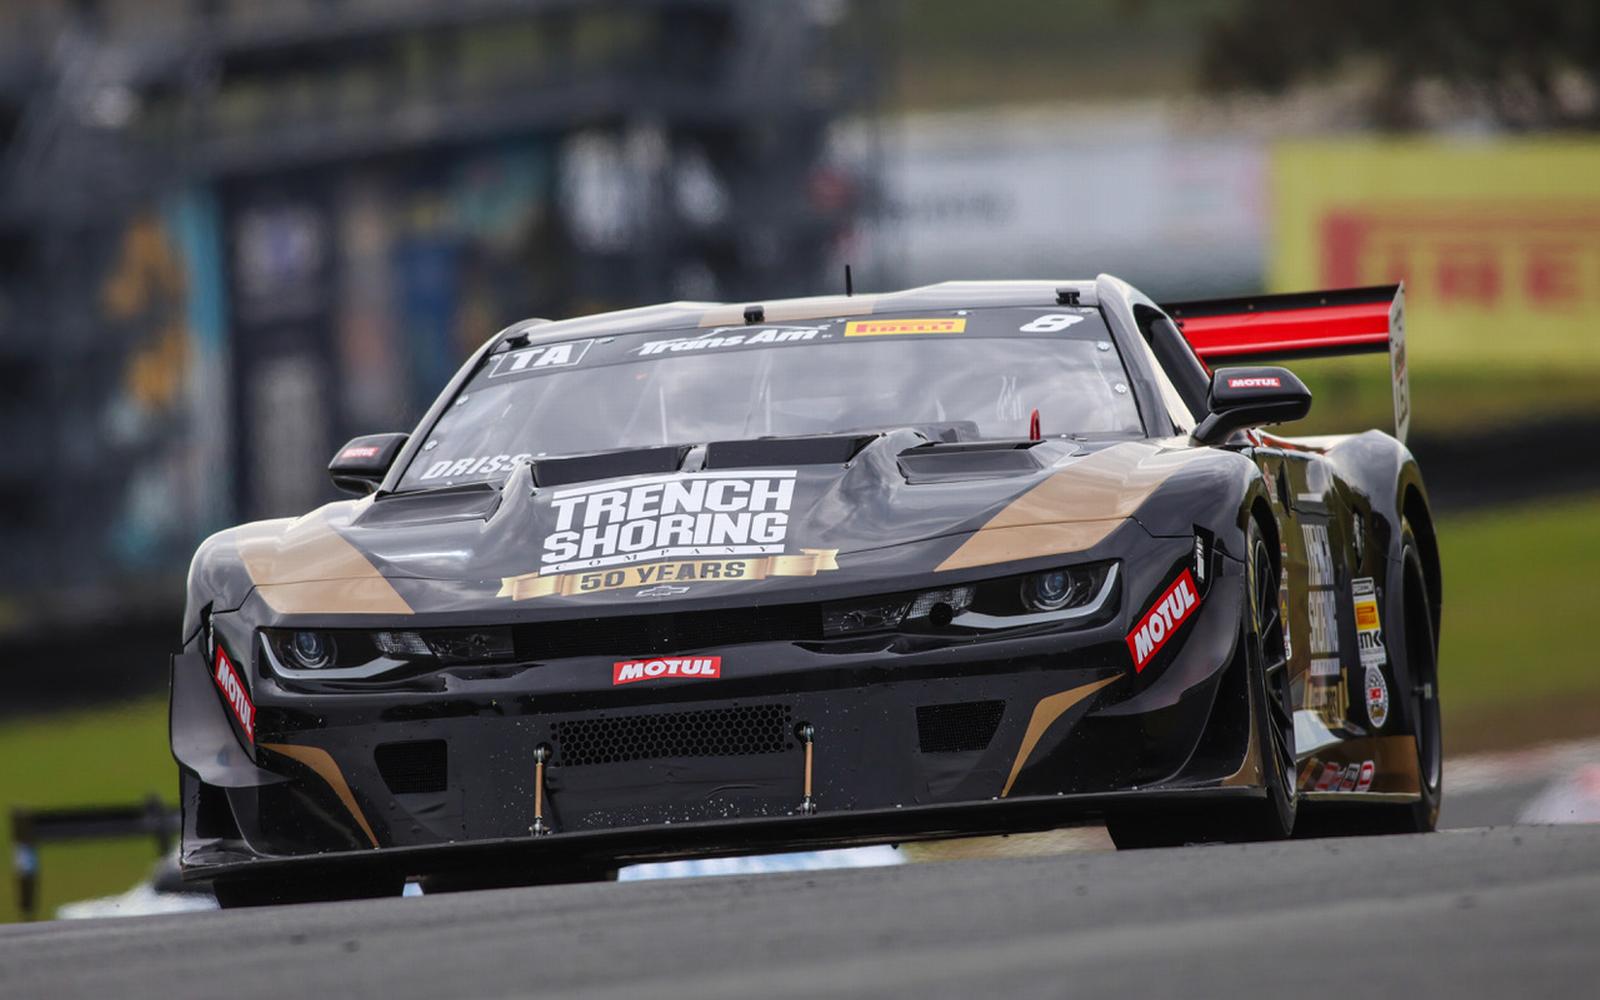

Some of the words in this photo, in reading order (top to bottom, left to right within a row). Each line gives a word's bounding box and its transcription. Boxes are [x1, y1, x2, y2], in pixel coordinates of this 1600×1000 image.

[856, 322, 955, 333] PIRELLI
[1019, 314, 1084, 333] 8
[637, 333, 739, 356] Trans
[747, 329, 820, 344] Am
[508, 344, 573, 371] TA
[1231, 378, 1279, 387] MOTUL
[420, 453, 547, 480] DRISS
[551, 479, 796, 531] TRENCH
[541, 512, 788, 563] SHORING
[555, 545, 770, 571] COMPANY
[580, 571, 626, 591] 50
[637, 562, 747, 583] YEARS
[1134, 580, 1196, 664] MOTUL
[618, 660, 716, 681] MOTUL
[217, 656, 252, 734] MOTUL
